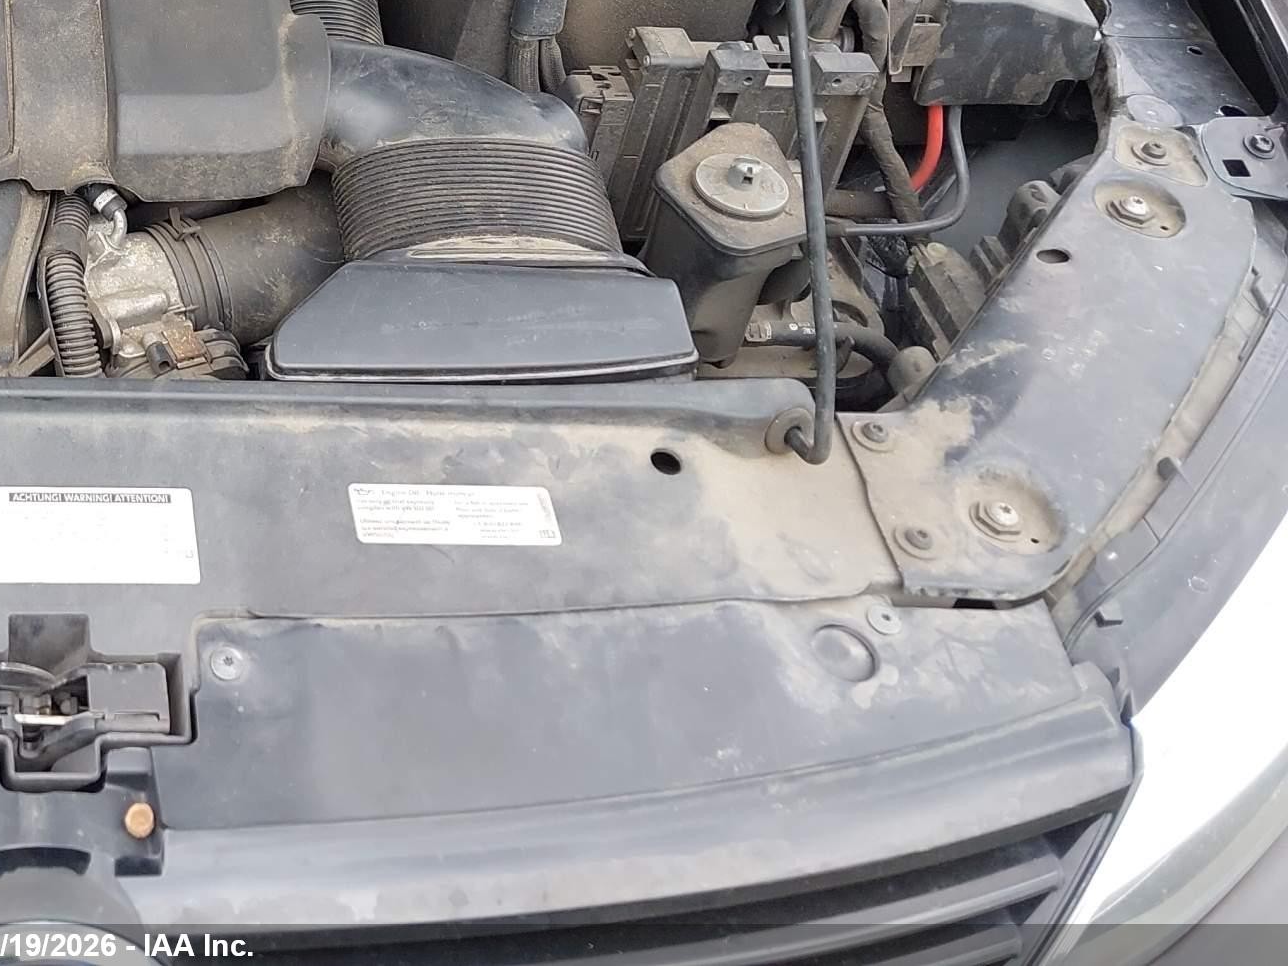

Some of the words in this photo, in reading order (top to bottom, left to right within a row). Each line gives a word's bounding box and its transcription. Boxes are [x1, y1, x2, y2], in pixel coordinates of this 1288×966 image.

[11, 492, 61, 503] ACHTUNG!
[63, 493, 112, 503] WARNING!
[114, 493, 170, 504] ATTENTION!
